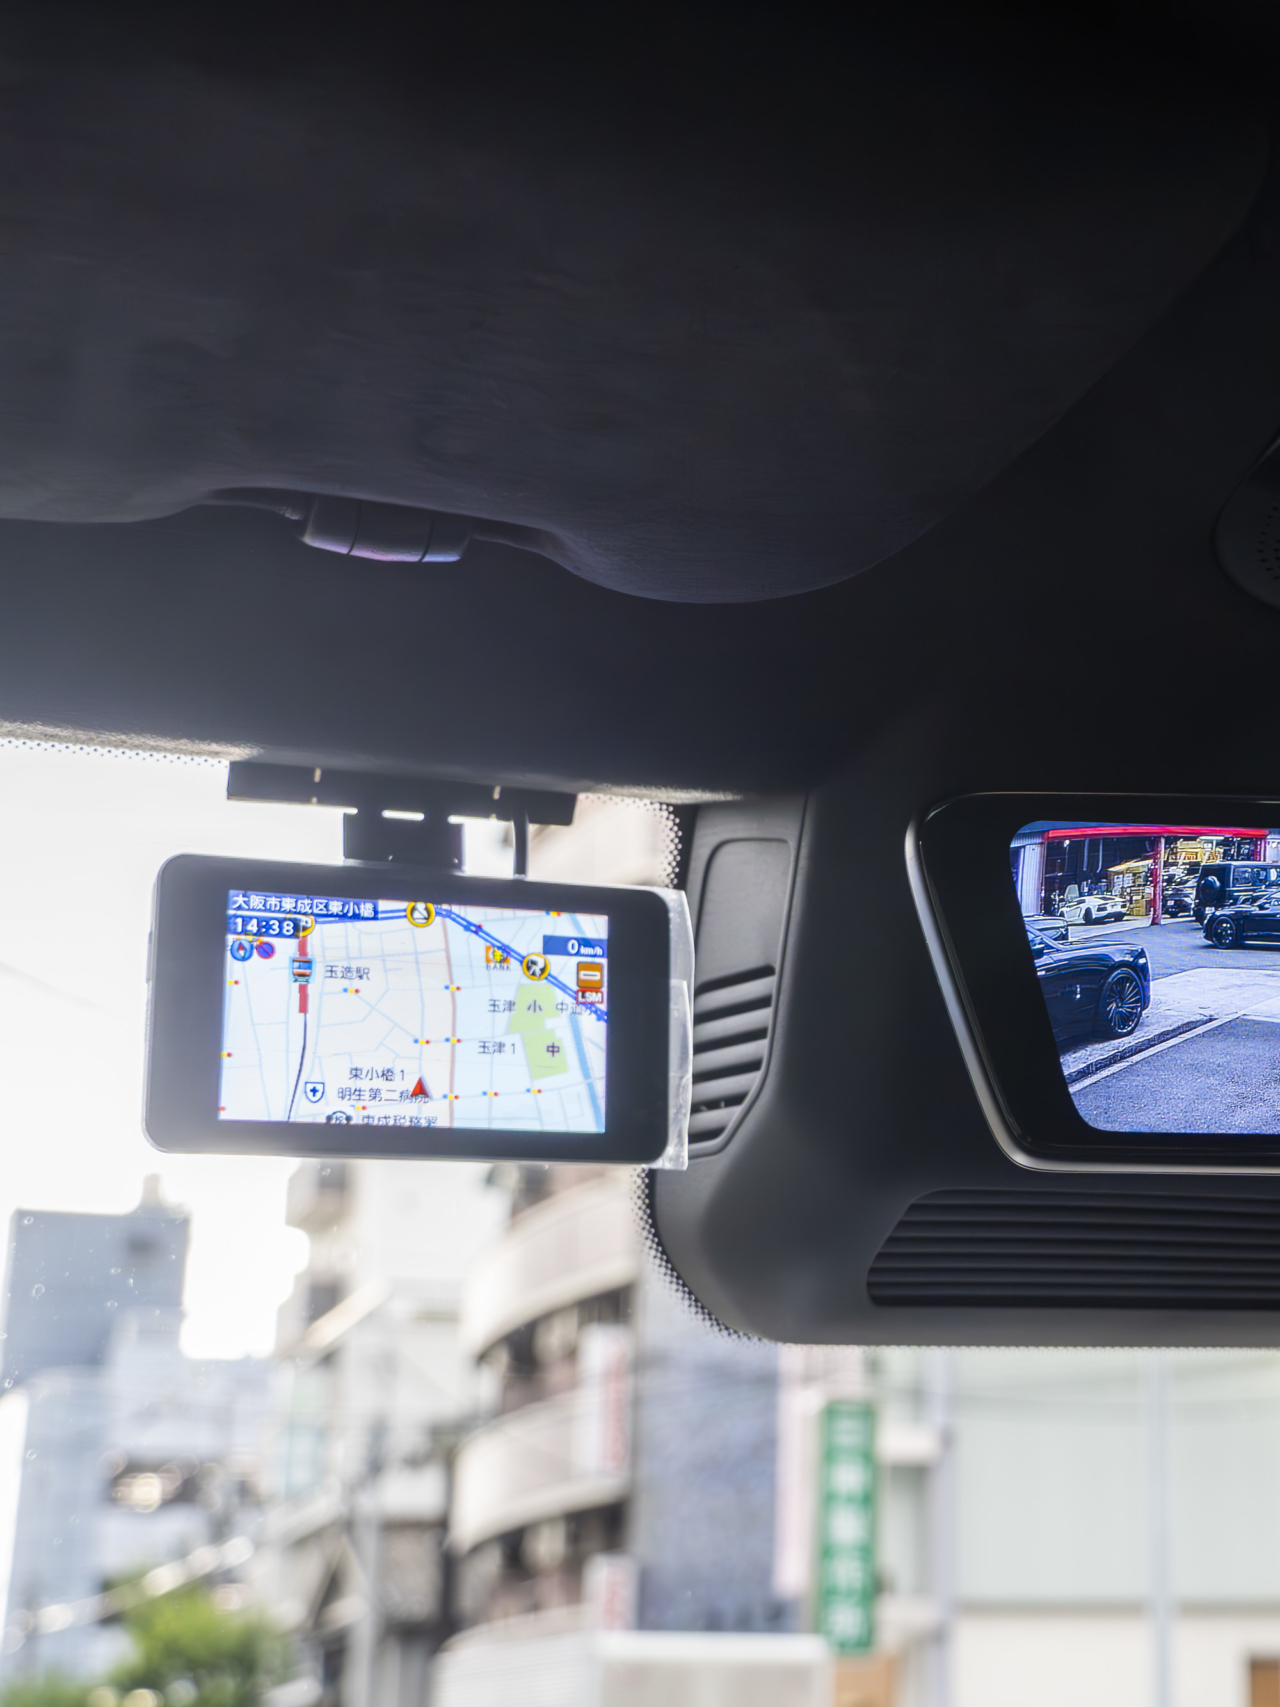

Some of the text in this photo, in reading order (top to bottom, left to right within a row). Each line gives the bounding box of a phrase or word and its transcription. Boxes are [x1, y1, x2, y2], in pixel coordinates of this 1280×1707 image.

[232, 893, 375, 918] 大阪市東成区東小橋
[234, 917, 295, 936] 14:38
[567, 939, 603, 956] 0 km/h
[324, 964, 371, 981] 玉造駅
[485, 963, 512, 972] BANK
[577, 991, 603, 1003] LSM
[546, 1042, 560, 1057] 中
[348, 1066, 396, 1081] 東小橋
